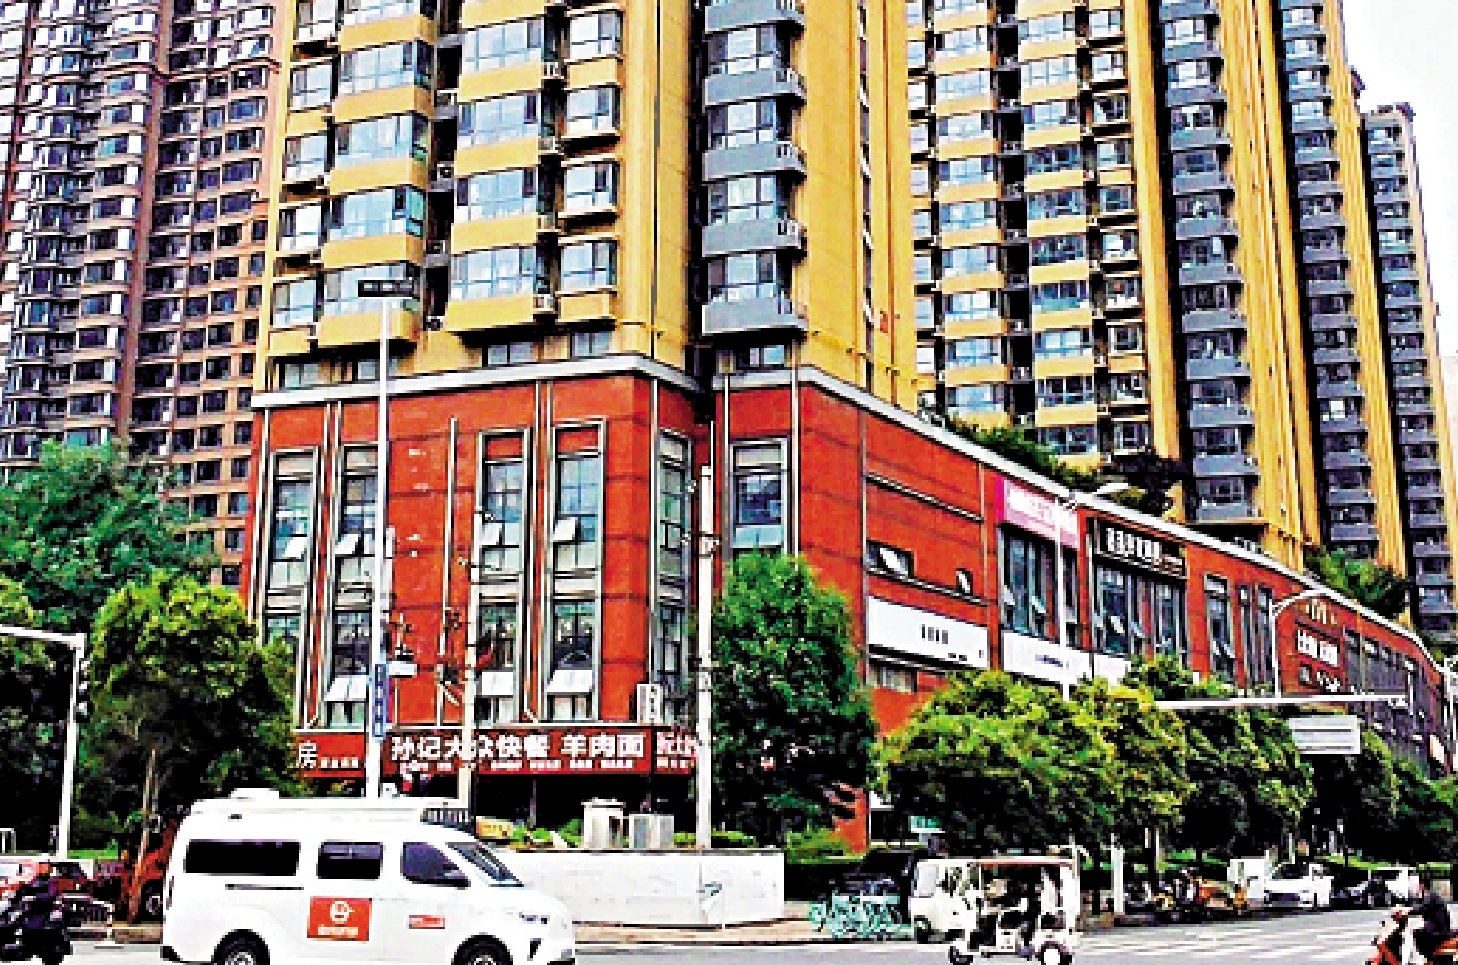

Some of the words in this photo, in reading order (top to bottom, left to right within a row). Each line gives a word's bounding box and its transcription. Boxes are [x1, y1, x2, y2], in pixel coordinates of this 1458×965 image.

[391, 735, 549, 760] 孙记大众快餐
[561, 734, 645, 758] 羊肉面
